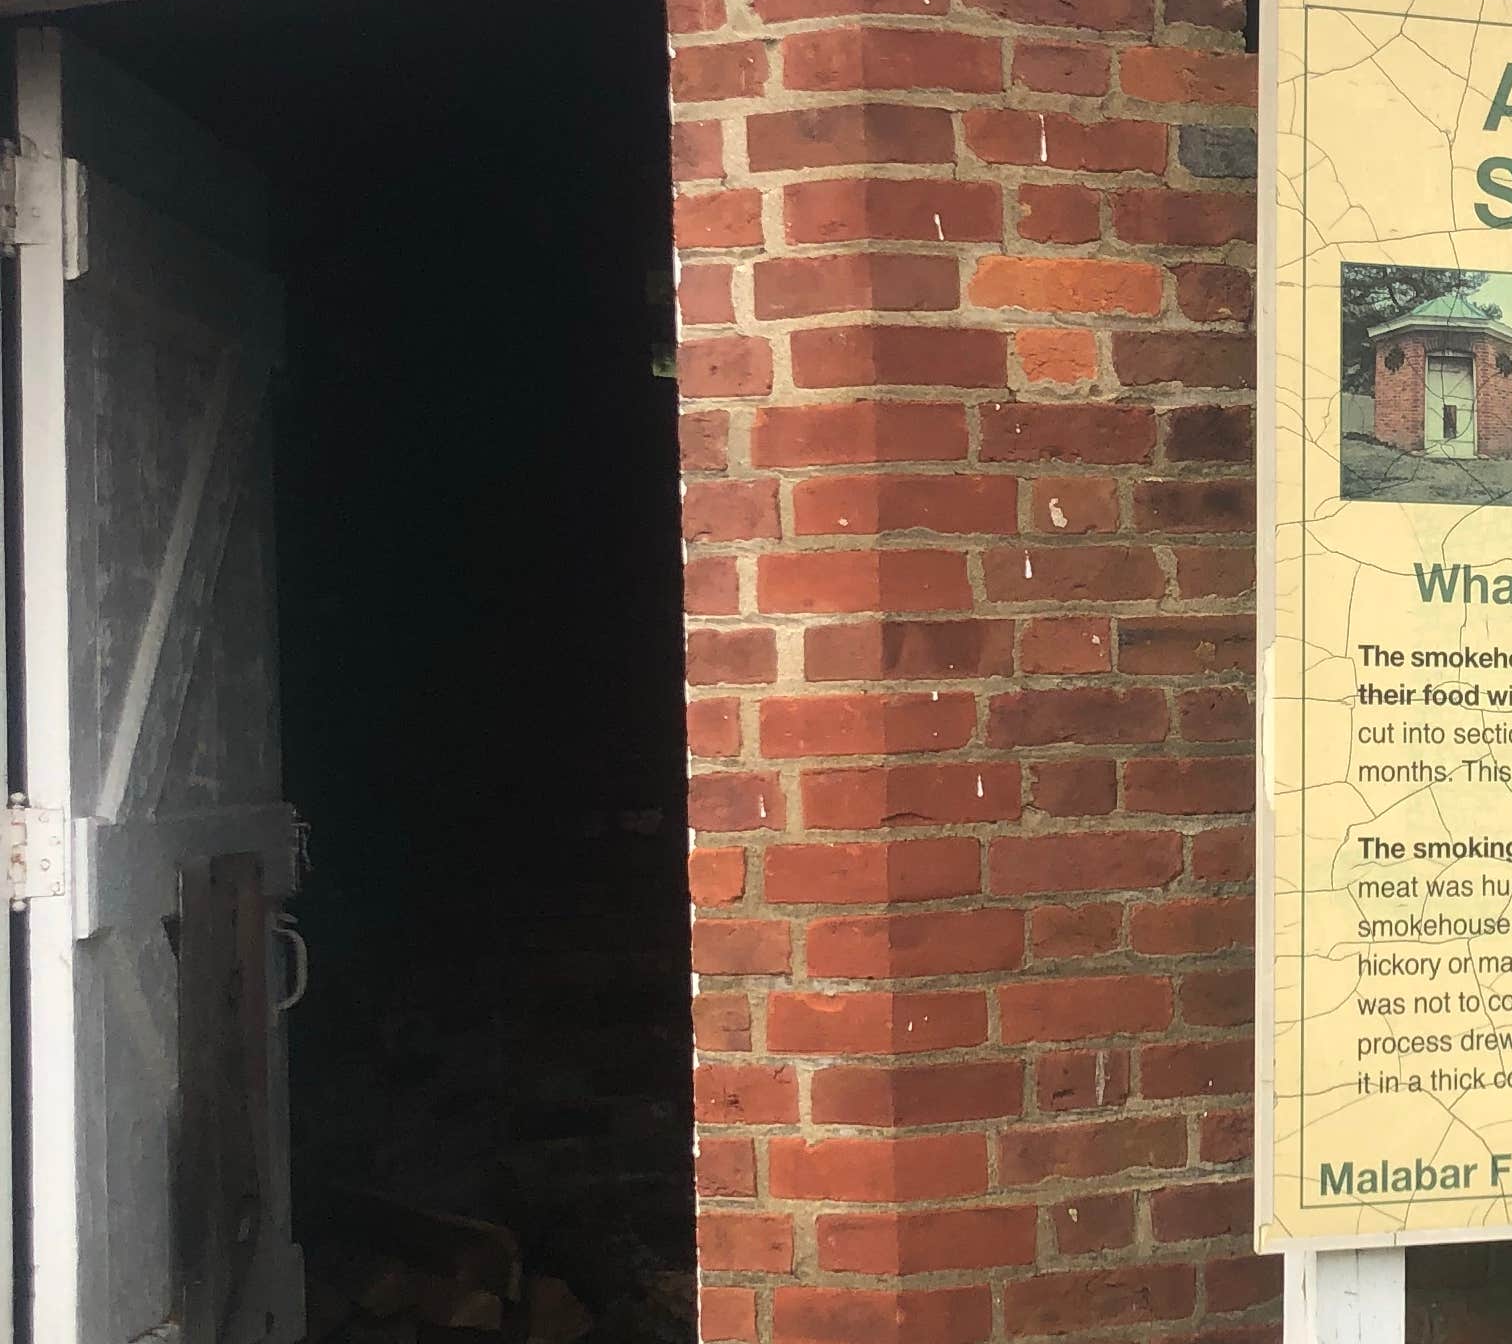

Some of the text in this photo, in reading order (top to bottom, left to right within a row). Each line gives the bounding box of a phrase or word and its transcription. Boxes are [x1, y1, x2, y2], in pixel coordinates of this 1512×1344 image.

[1358, 645, 1405, 667] The
[1358, 684, 1416, 705] their
[1422, 685, 1479, 706] food
[1358, 724, 1394, 743] cut
[1402, 723, 1445, 744] into
[1358, 762, 1455, 783] months.
[1460, 762, 1511, 782] This
[1357, 838, 1406, 859] The
[1357, 953, 1441, 982] hickory
[1448, 958, 1472, 974] or
[1357, 998, 1406, 1015] was
[1414, 993, 1451, 1013] not
[1458, 992, 1482, 1012] to
[1356, 1036, 1452, 1060] process
[1320, 1155, 1477, 1195] Malabar
